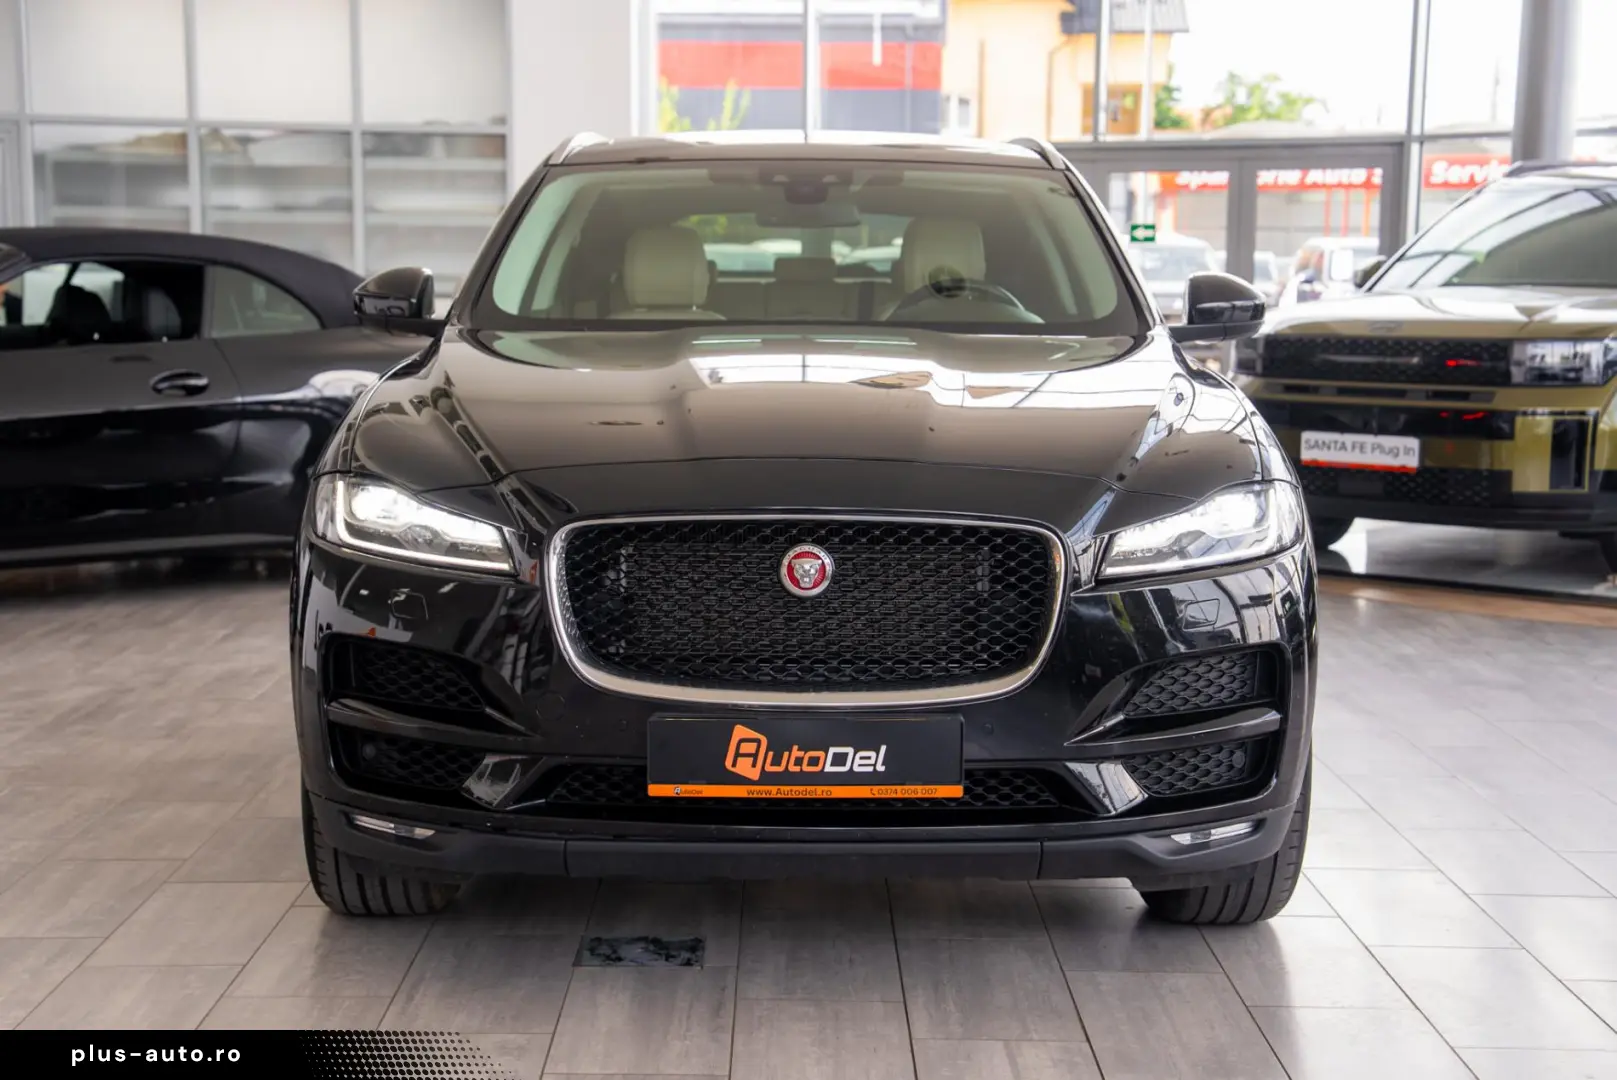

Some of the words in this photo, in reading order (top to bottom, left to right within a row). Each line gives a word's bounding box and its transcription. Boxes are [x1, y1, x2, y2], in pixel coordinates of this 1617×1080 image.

[1304, 438, 1348, 453] SANTA
[1351, 441, 1367, 455] FE
[1370, 442, 1400, 459] Plug
[1403, 444, 1416, 457] In
[728, 732, 887, 774] AutoDel
[746, 787, 833, 797] www.Autodel.ro
[877, 787, 898, 796] 0374
[900, 787, 919, 796] 006
[920, 787, 938, 796] 007
